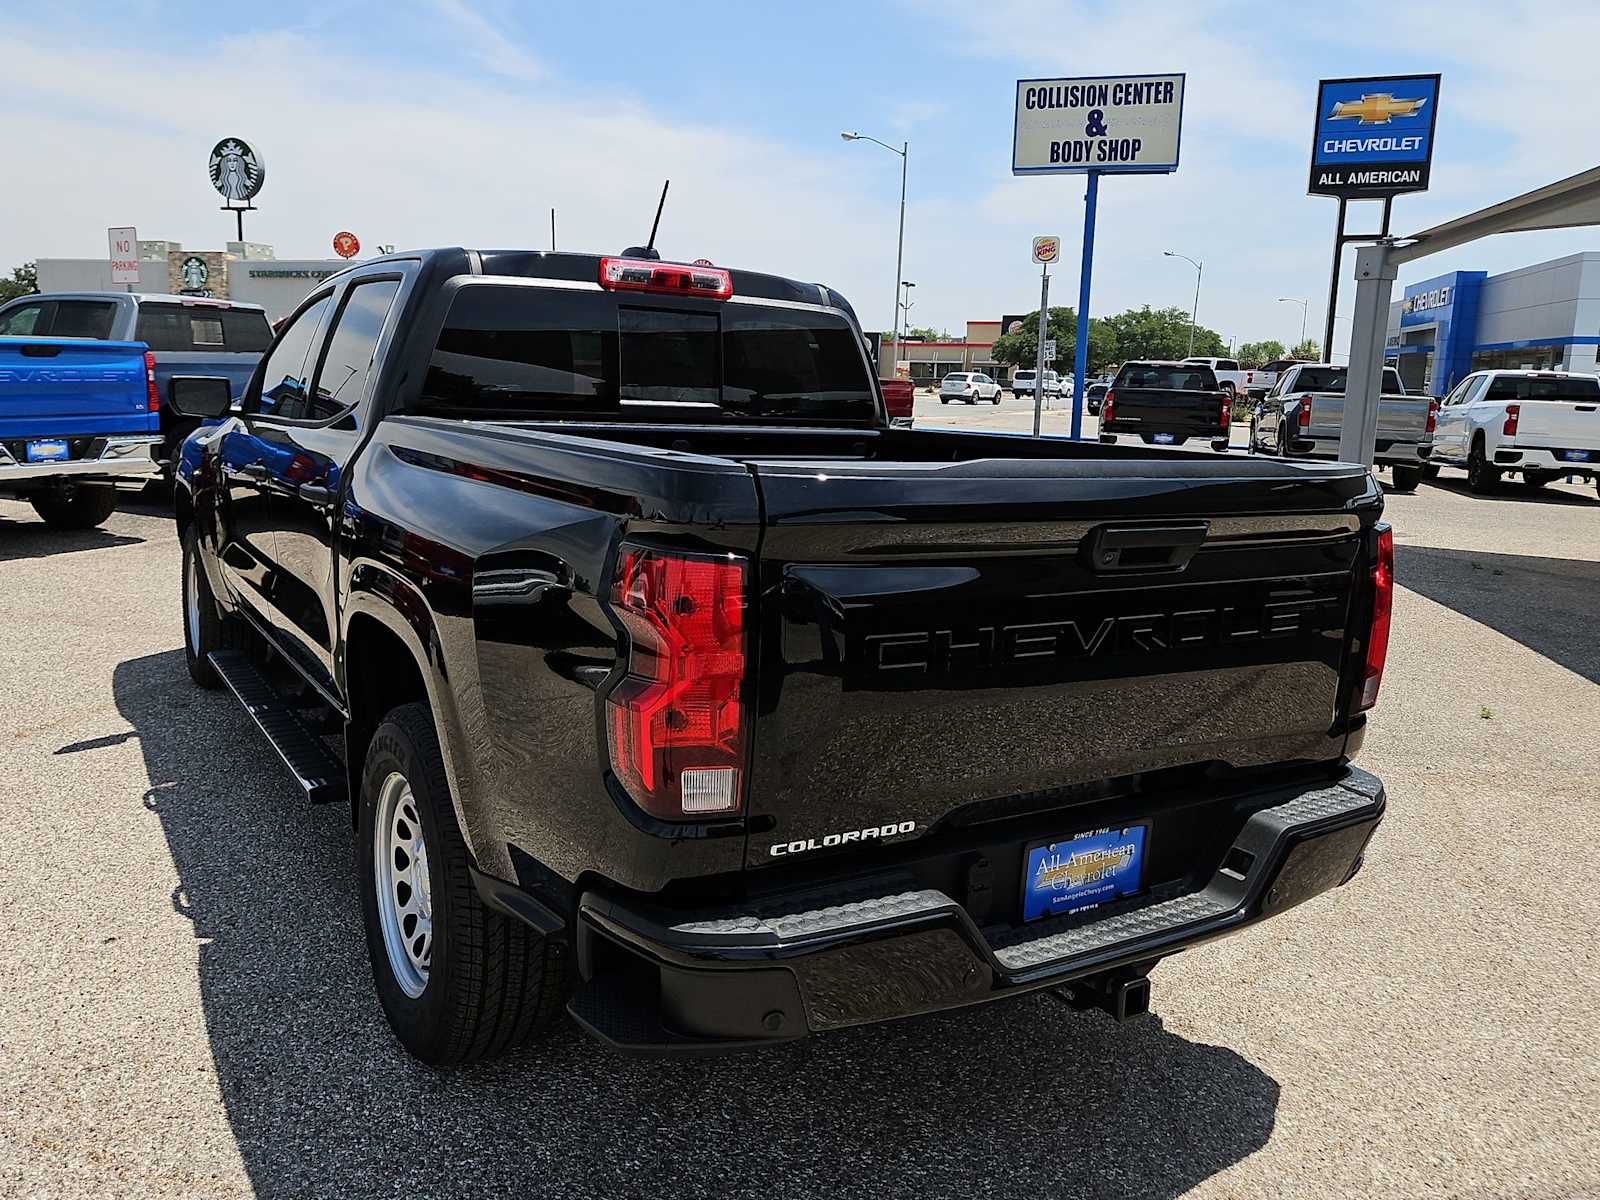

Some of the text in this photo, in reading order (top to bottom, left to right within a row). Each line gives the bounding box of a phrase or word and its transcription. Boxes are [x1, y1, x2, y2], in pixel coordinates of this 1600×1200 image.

[1025, 81, 1174, 110] COLLISION CENTER
[1085, 108, 1108, 137] &
[1049, 138, 1142, 163] BODY SHOP
[1323, 136, 1423, 153] CHEVROLET
[1318, 170, 1420, 185] ALL AMERICAN
[116, 240, 130, 252] NO
[1037, 246, 1056, 257] KING
[112, 260, 138, 271] PARKING
[249, 269, 309, 278] STARBUCKS
[1413, 287, 1451, 312] CHEVROLET
[770, 820, 916, 856] COLORADO
[1036, 843, 1135, 875] All American
[1051, 863, 1117, 890] Chevrolet
